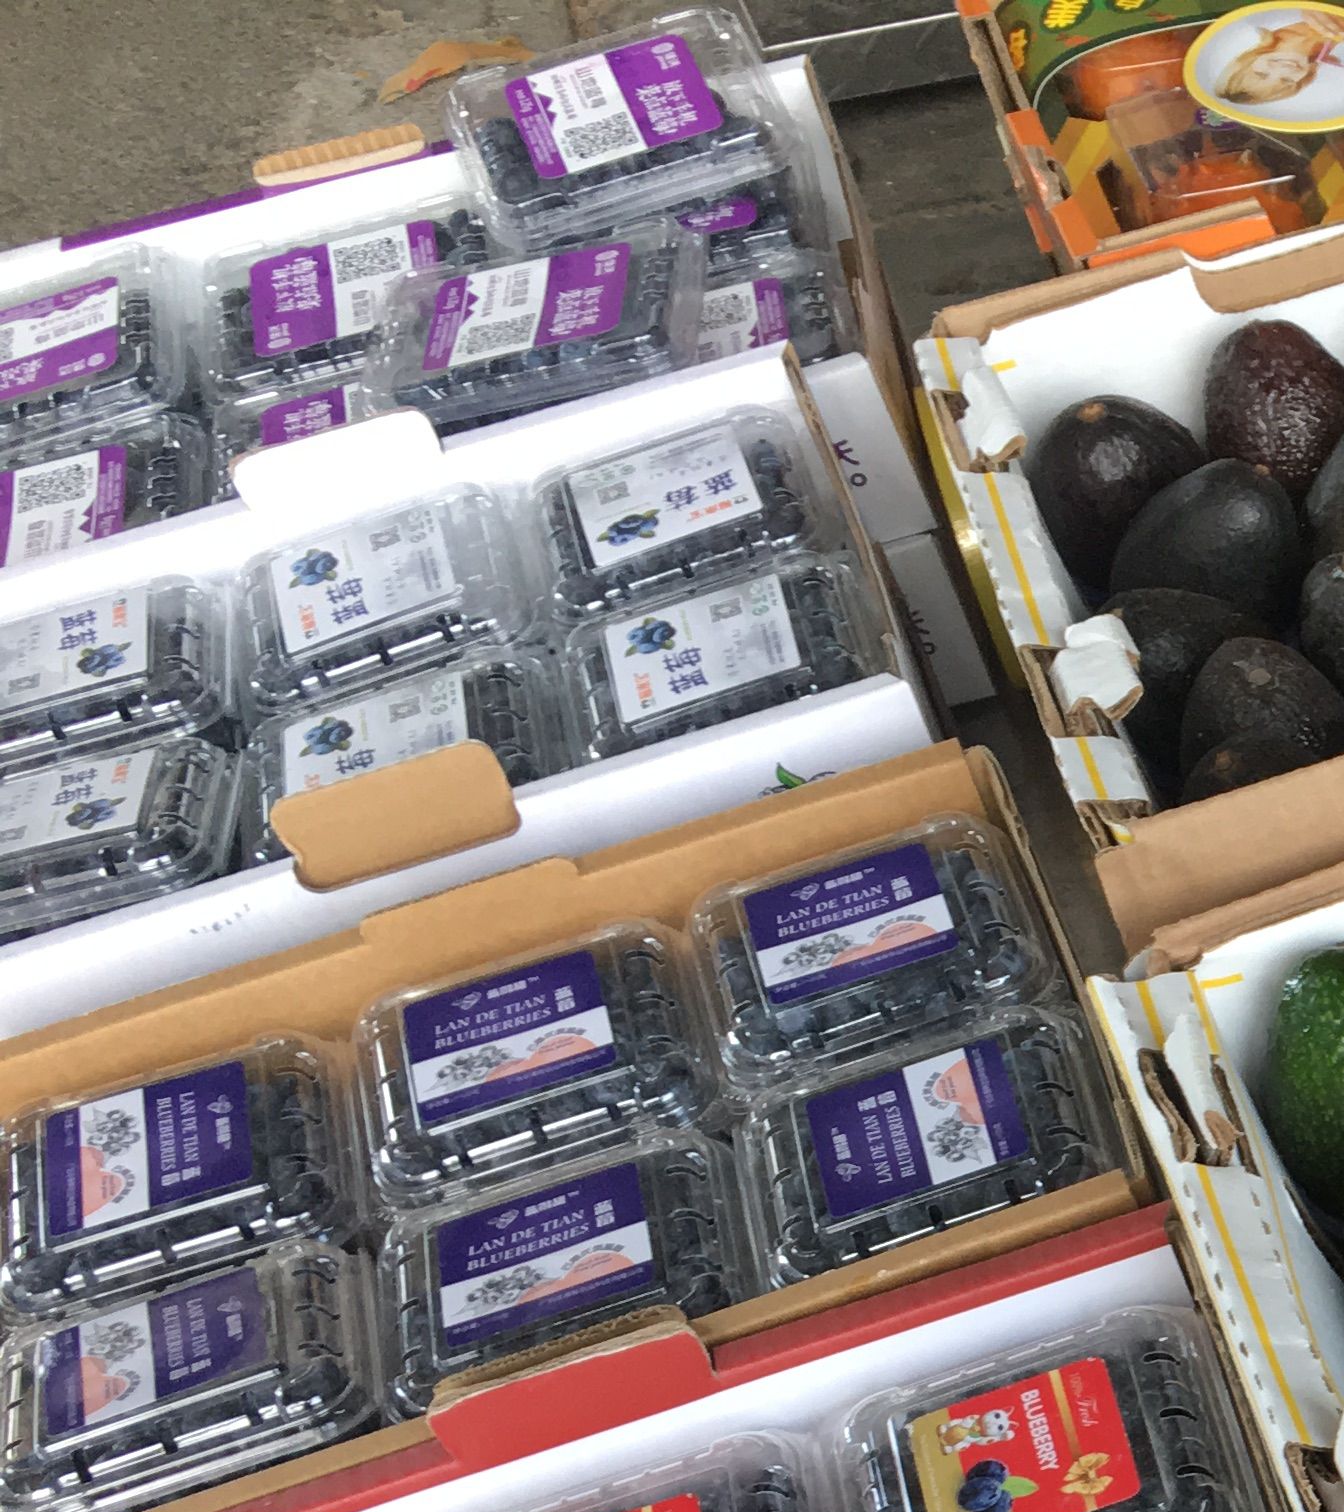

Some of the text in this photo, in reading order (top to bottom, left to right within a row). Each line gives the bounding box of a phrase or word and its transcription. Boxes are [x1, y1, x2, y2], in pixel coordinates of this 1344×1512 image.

[662, 647, 709, 694] 蓝莓
[776, 885, 882, 924] LAN DE TIAN
[777, 896, 889, 937] BLUEBERRIES
[435, 995, 546, 1035] LAN DE TIAN
[435, 1007, 552, 1049] BLUEBERRIES
[157, 1097, 176, 1172] BLUEBERRIES
[179, 1092, 199, 1163] LAN DE TIAN
[863, 1115, 893, 1184] LAN DE TIAN
[885, 1106, 916, 1178] BLUEBERRIES
[467, 1223, 589, 1271] BLUEBERRIES
[468, 1210, 585, 1255] LAN DE TIAN
[1020, 1388, 1059, 1471] BLUEBERRY
